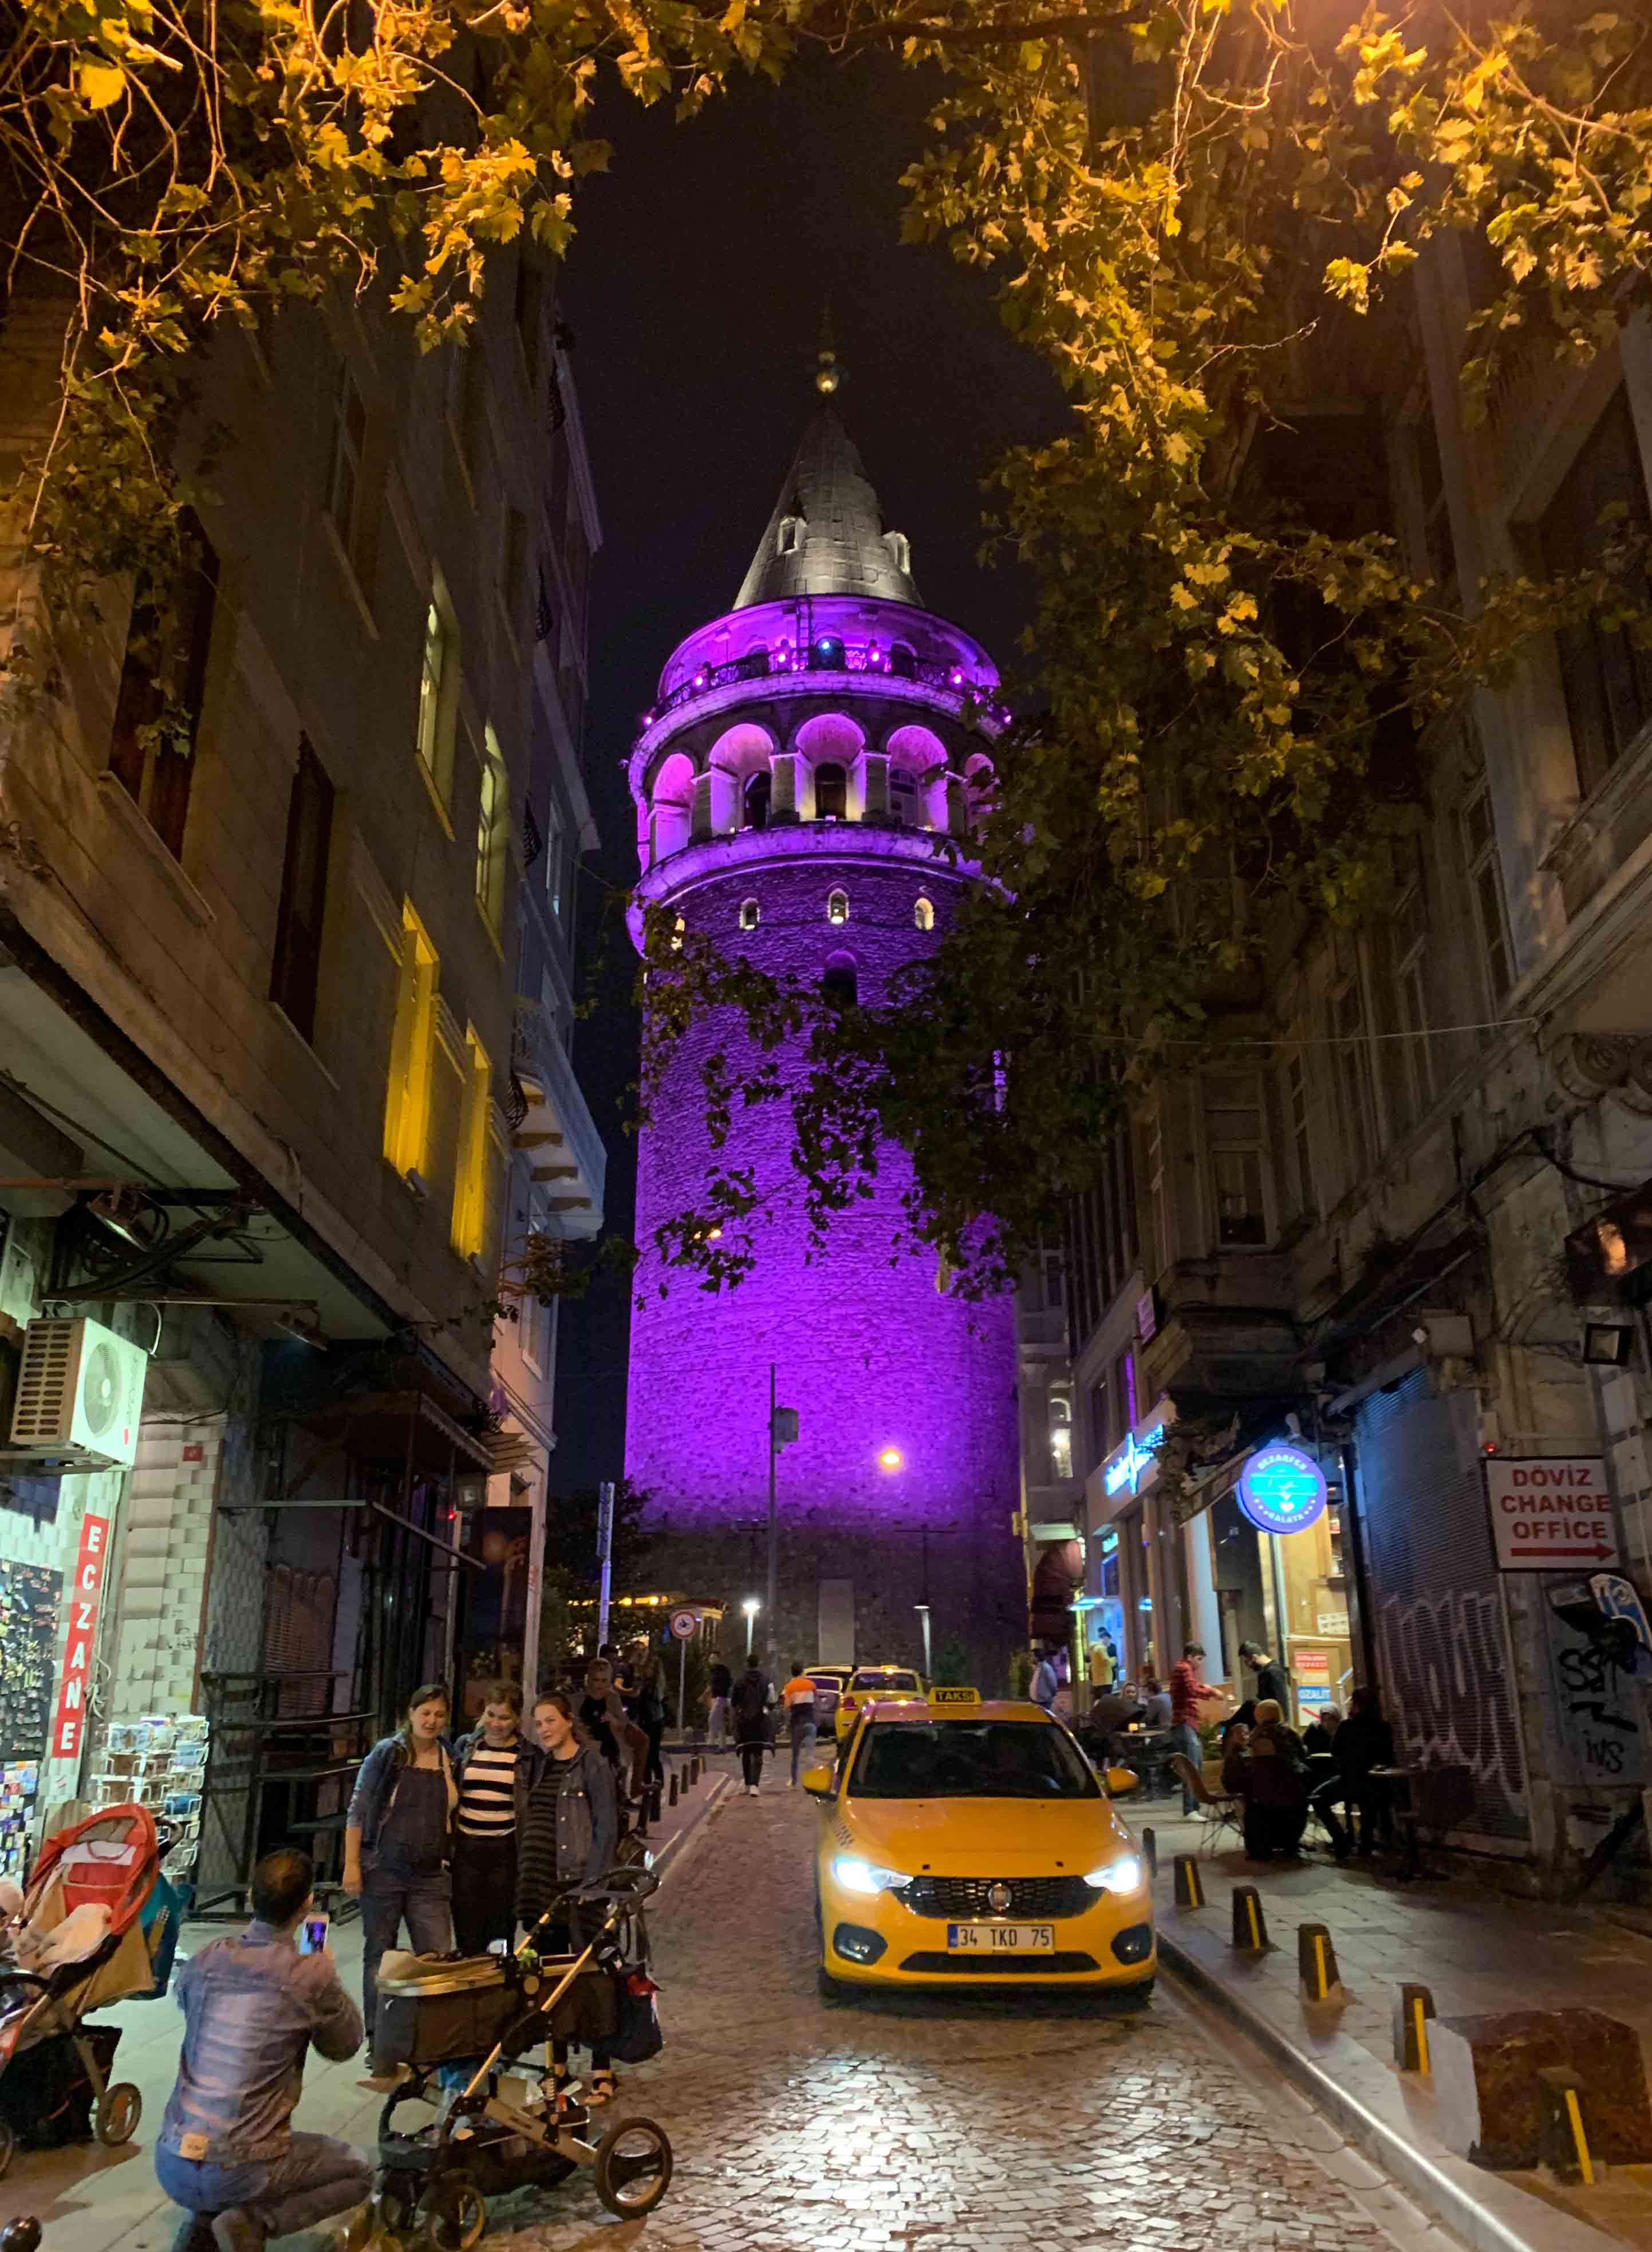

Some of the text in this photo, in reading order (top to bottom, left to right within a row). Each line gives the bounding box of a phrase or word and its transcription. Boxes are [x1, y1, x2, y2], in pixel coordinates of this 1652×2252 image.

[1500, 1494, 1611, 1513] CHANGE
[61, 1525, 102, 1751] ECZANE
[960, 1928, 977, 1946] 34
[1031, 1928, 1050, 1946] 75
